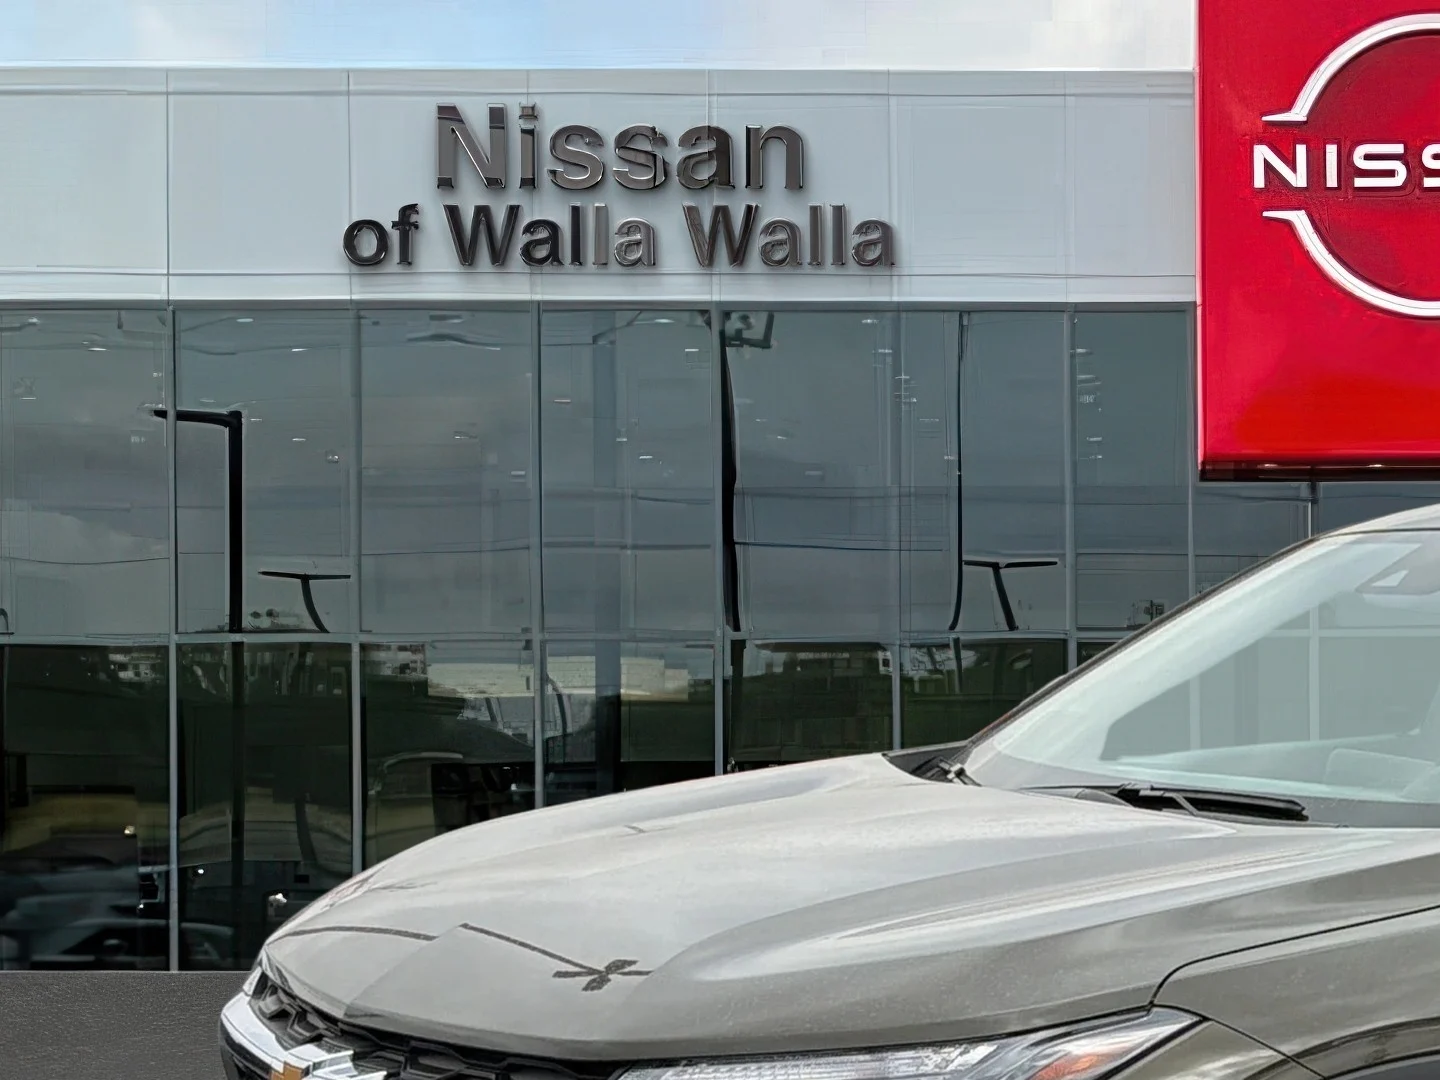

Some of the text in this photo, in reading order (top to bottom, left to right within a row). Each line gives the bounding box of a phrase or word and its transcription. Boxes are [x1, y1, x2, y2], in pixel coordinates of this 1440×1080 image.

[436, 102, 805, 191] Nissan
[342, 202, 896, 267] of Walla Walla
